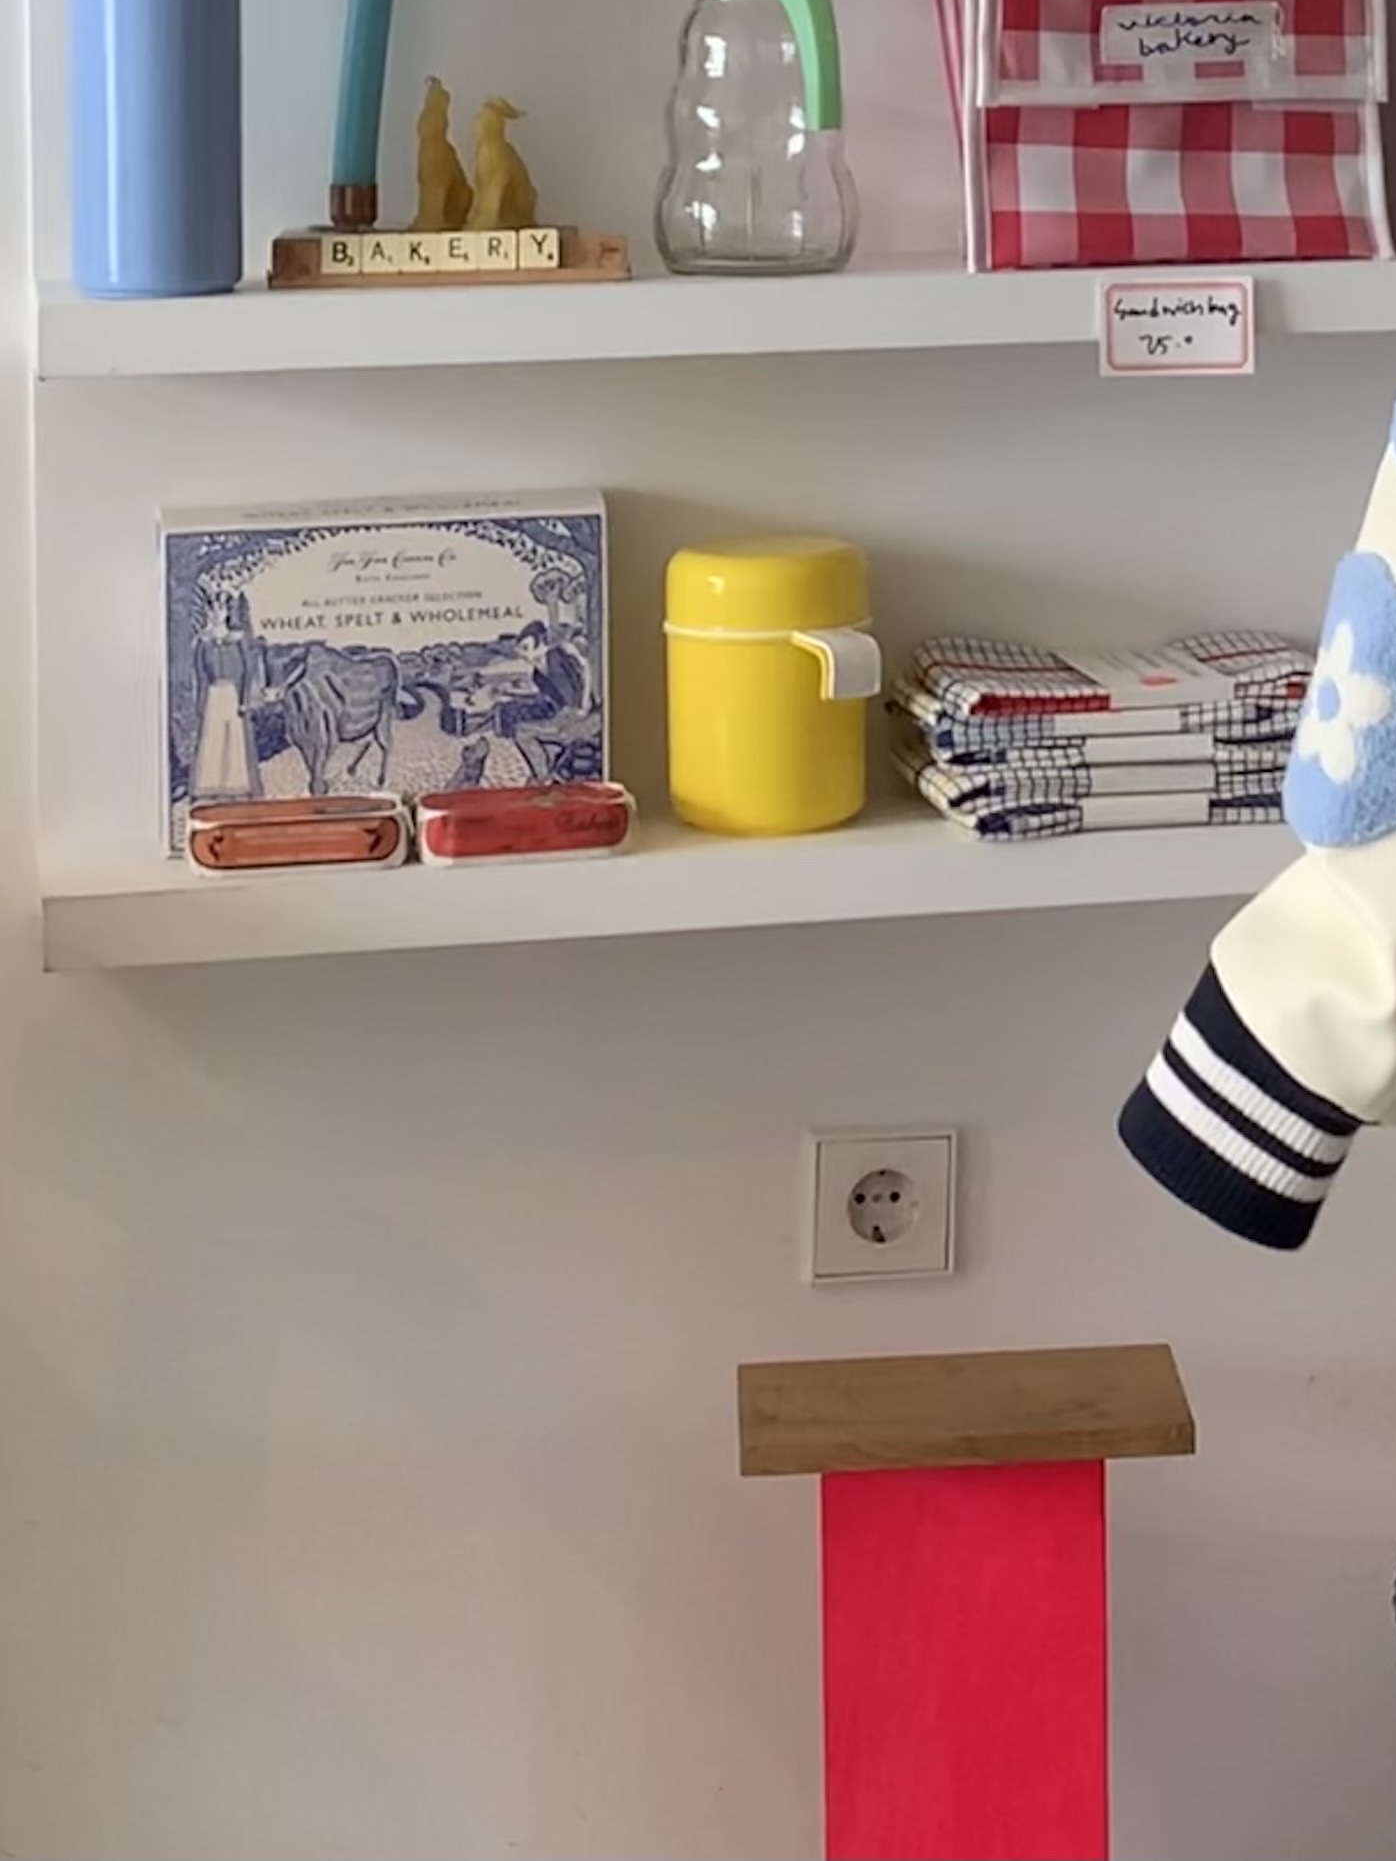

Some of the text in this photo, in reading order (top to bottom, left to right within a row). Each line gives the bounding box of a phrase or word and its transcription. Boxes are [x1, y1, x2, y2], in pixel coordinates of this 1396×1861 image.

[1118, 12, 1261, 32] victoria
[1139, 28, 1251, 57] bakery
[331, 234, 554, 266] BAKERY
[370, 593, 419, 605] CRACKER
[424, 590, 482, 601] SELECTION
[335, 612, 384, 628] SPELT
[391, 611, 402, 625] &
[410, 606, 524, 624] WHOLEMEAL
